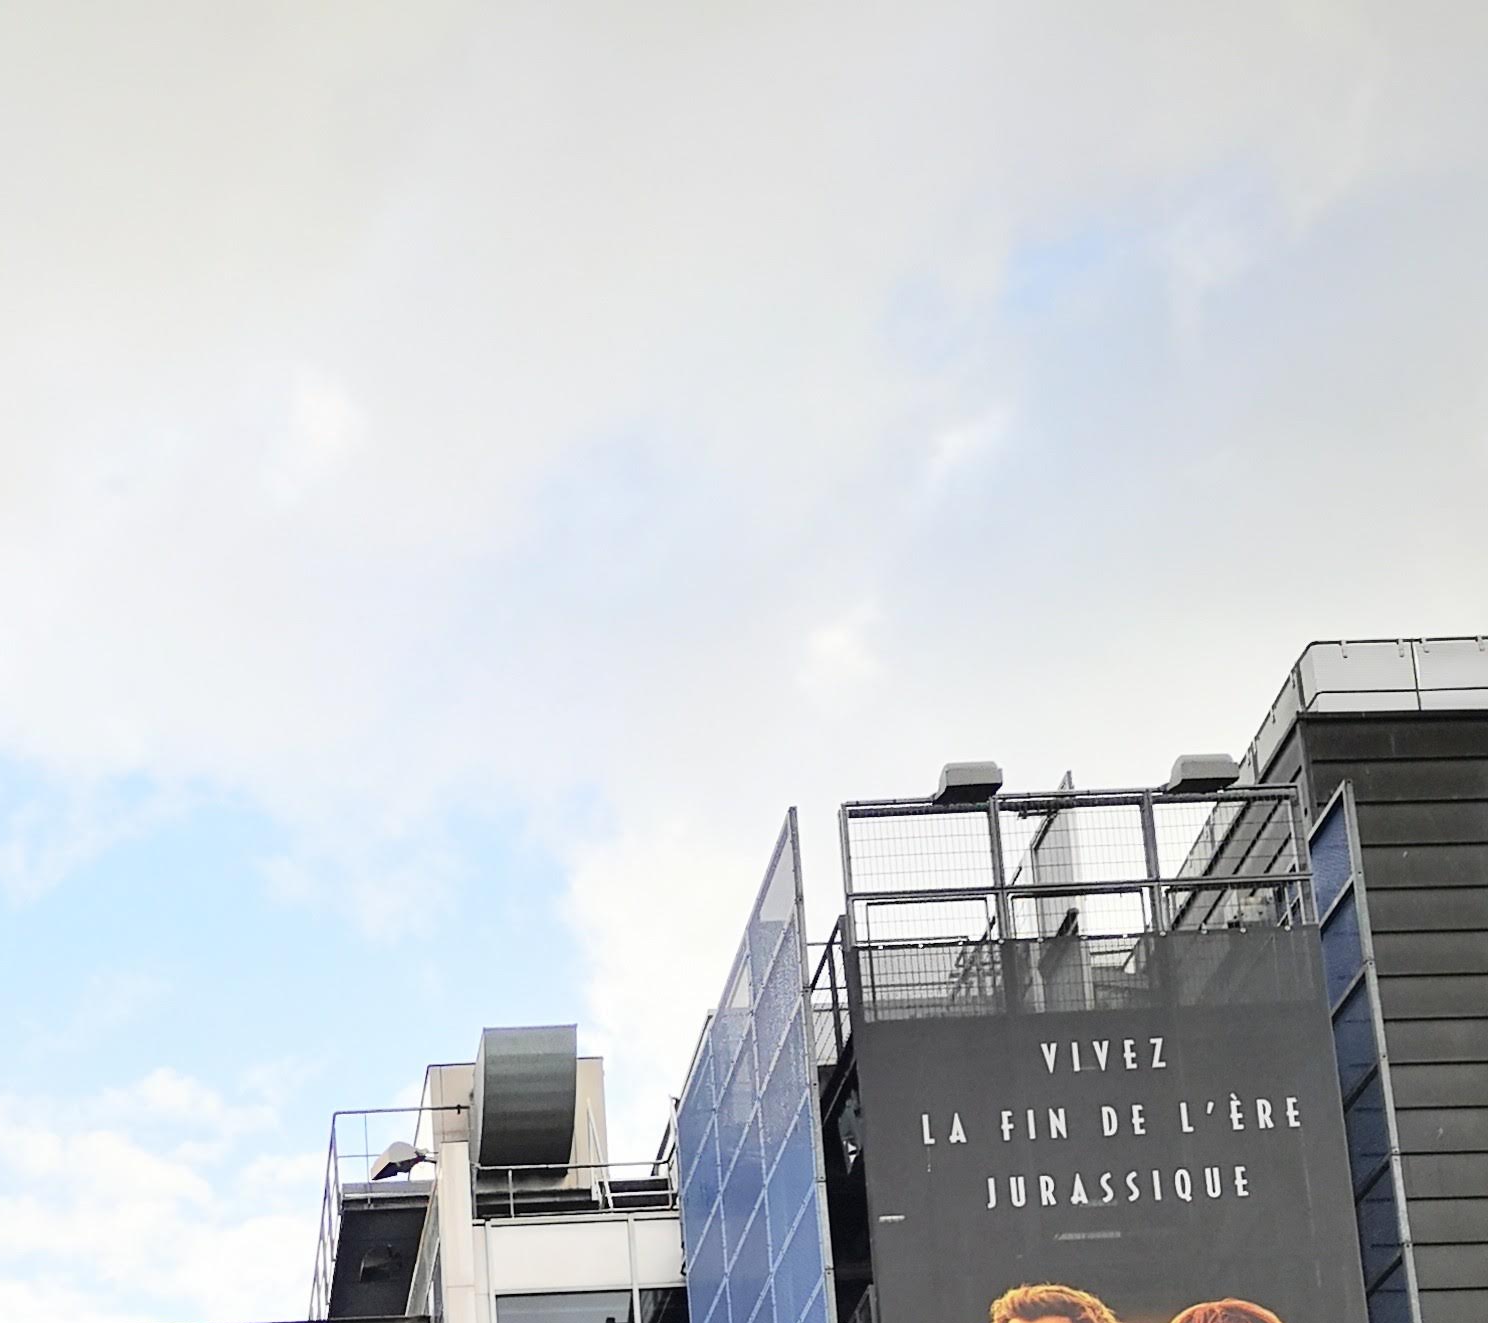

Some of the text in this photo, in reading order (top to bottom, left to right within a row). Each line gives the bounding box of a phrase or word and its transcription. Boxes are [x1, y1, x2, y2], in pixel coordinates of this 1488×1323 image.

[1041, 1037, 1166, 1073] VIVEZ
[920, 1092, 1301, 1146] LA FIN DE L'ÈRE
[986, 1164, 1251, 1210] JURASSIQUE
